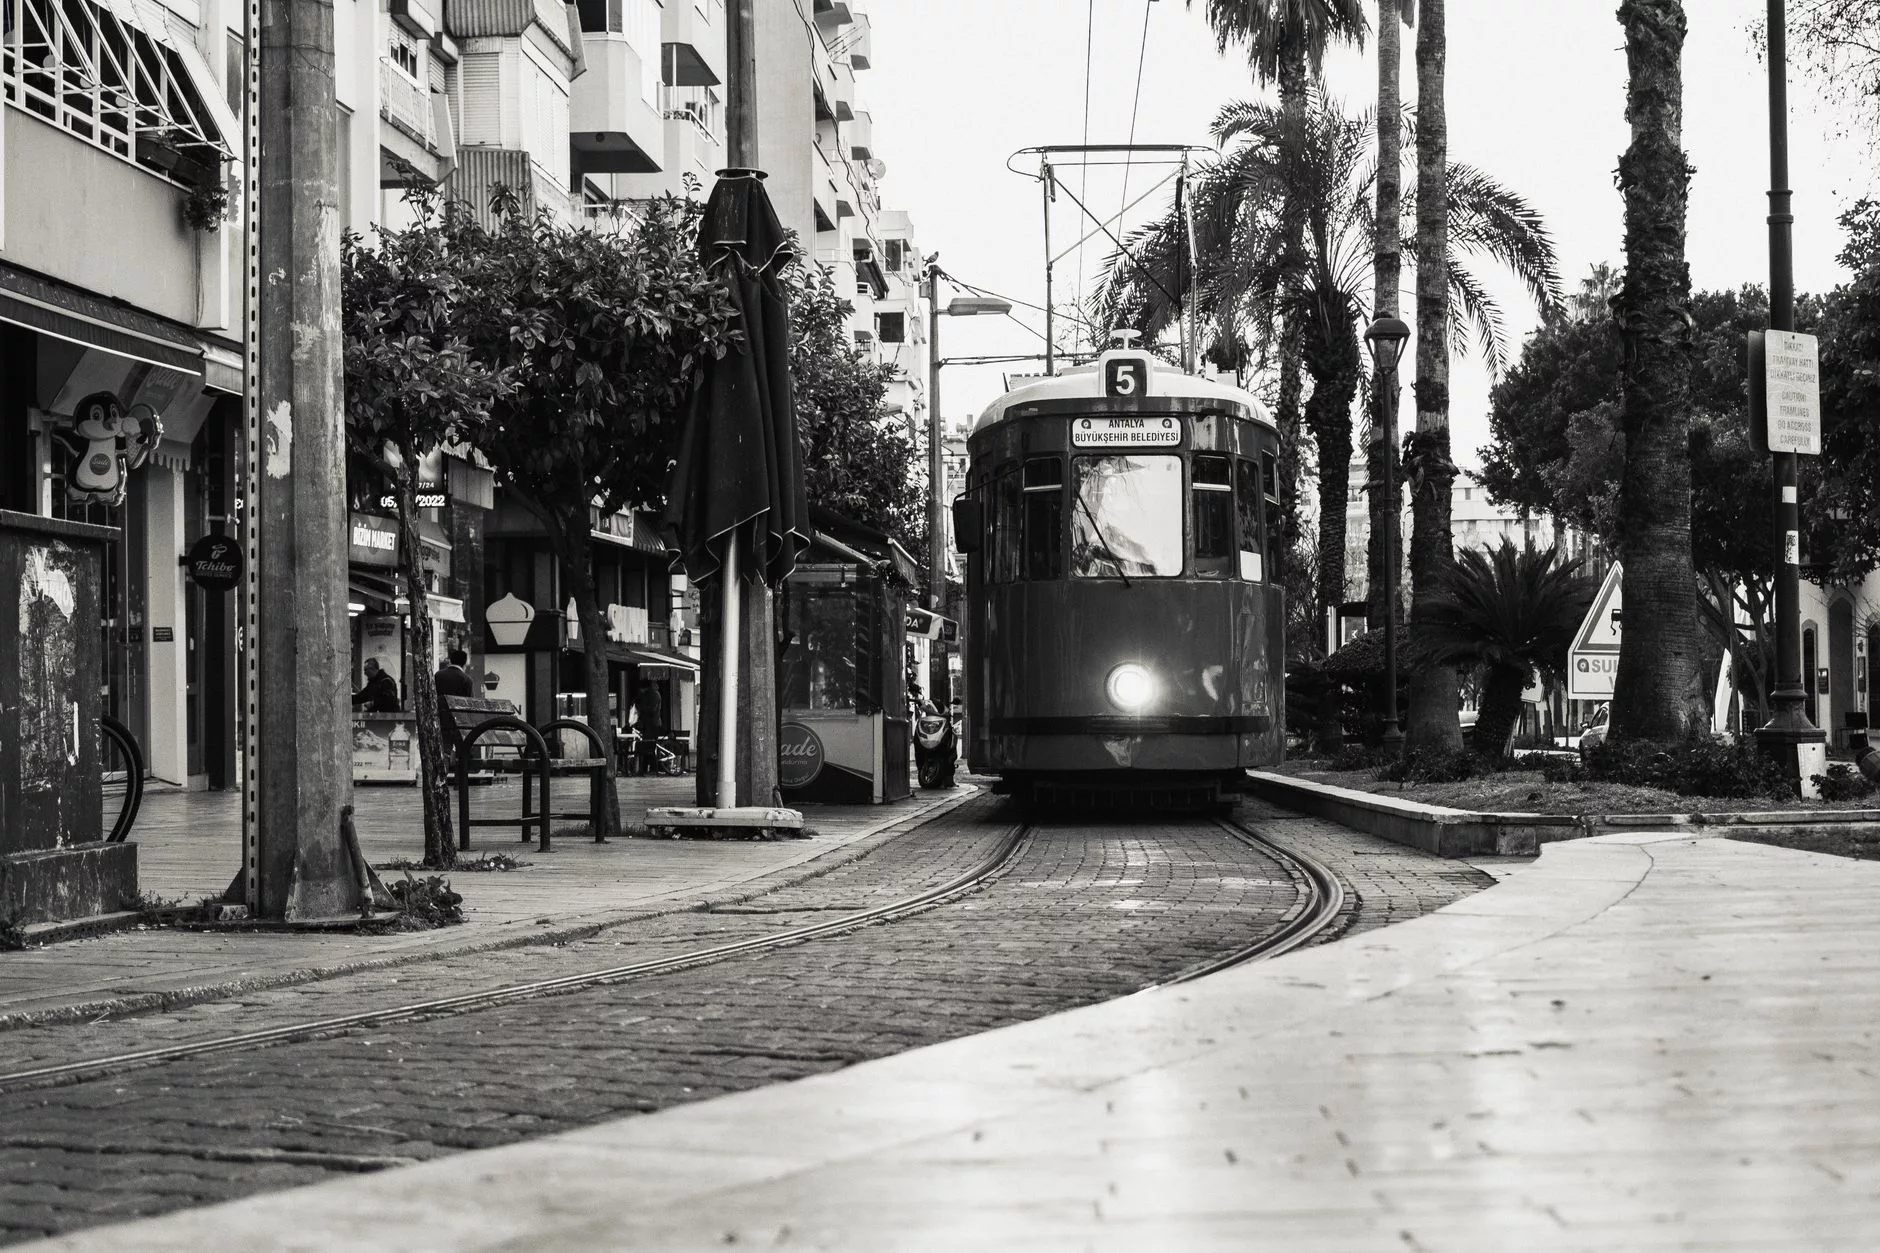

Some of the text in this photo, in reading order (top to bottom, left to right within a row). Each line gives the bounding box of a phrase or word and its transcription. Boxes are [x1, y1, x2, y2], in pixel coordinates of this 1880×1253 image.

[1115, 365, 1135, 395] 5
[1108, 418, 1145, 428] ANTALYA
[1075, 430, 1179, 443] BÜYÜKŞEHİR BELEDİYESİ
[371, 530, 396, 551] MARKET
[196, 560, 236, 572] Tchibo
[781, 735, 817, 757] ade
